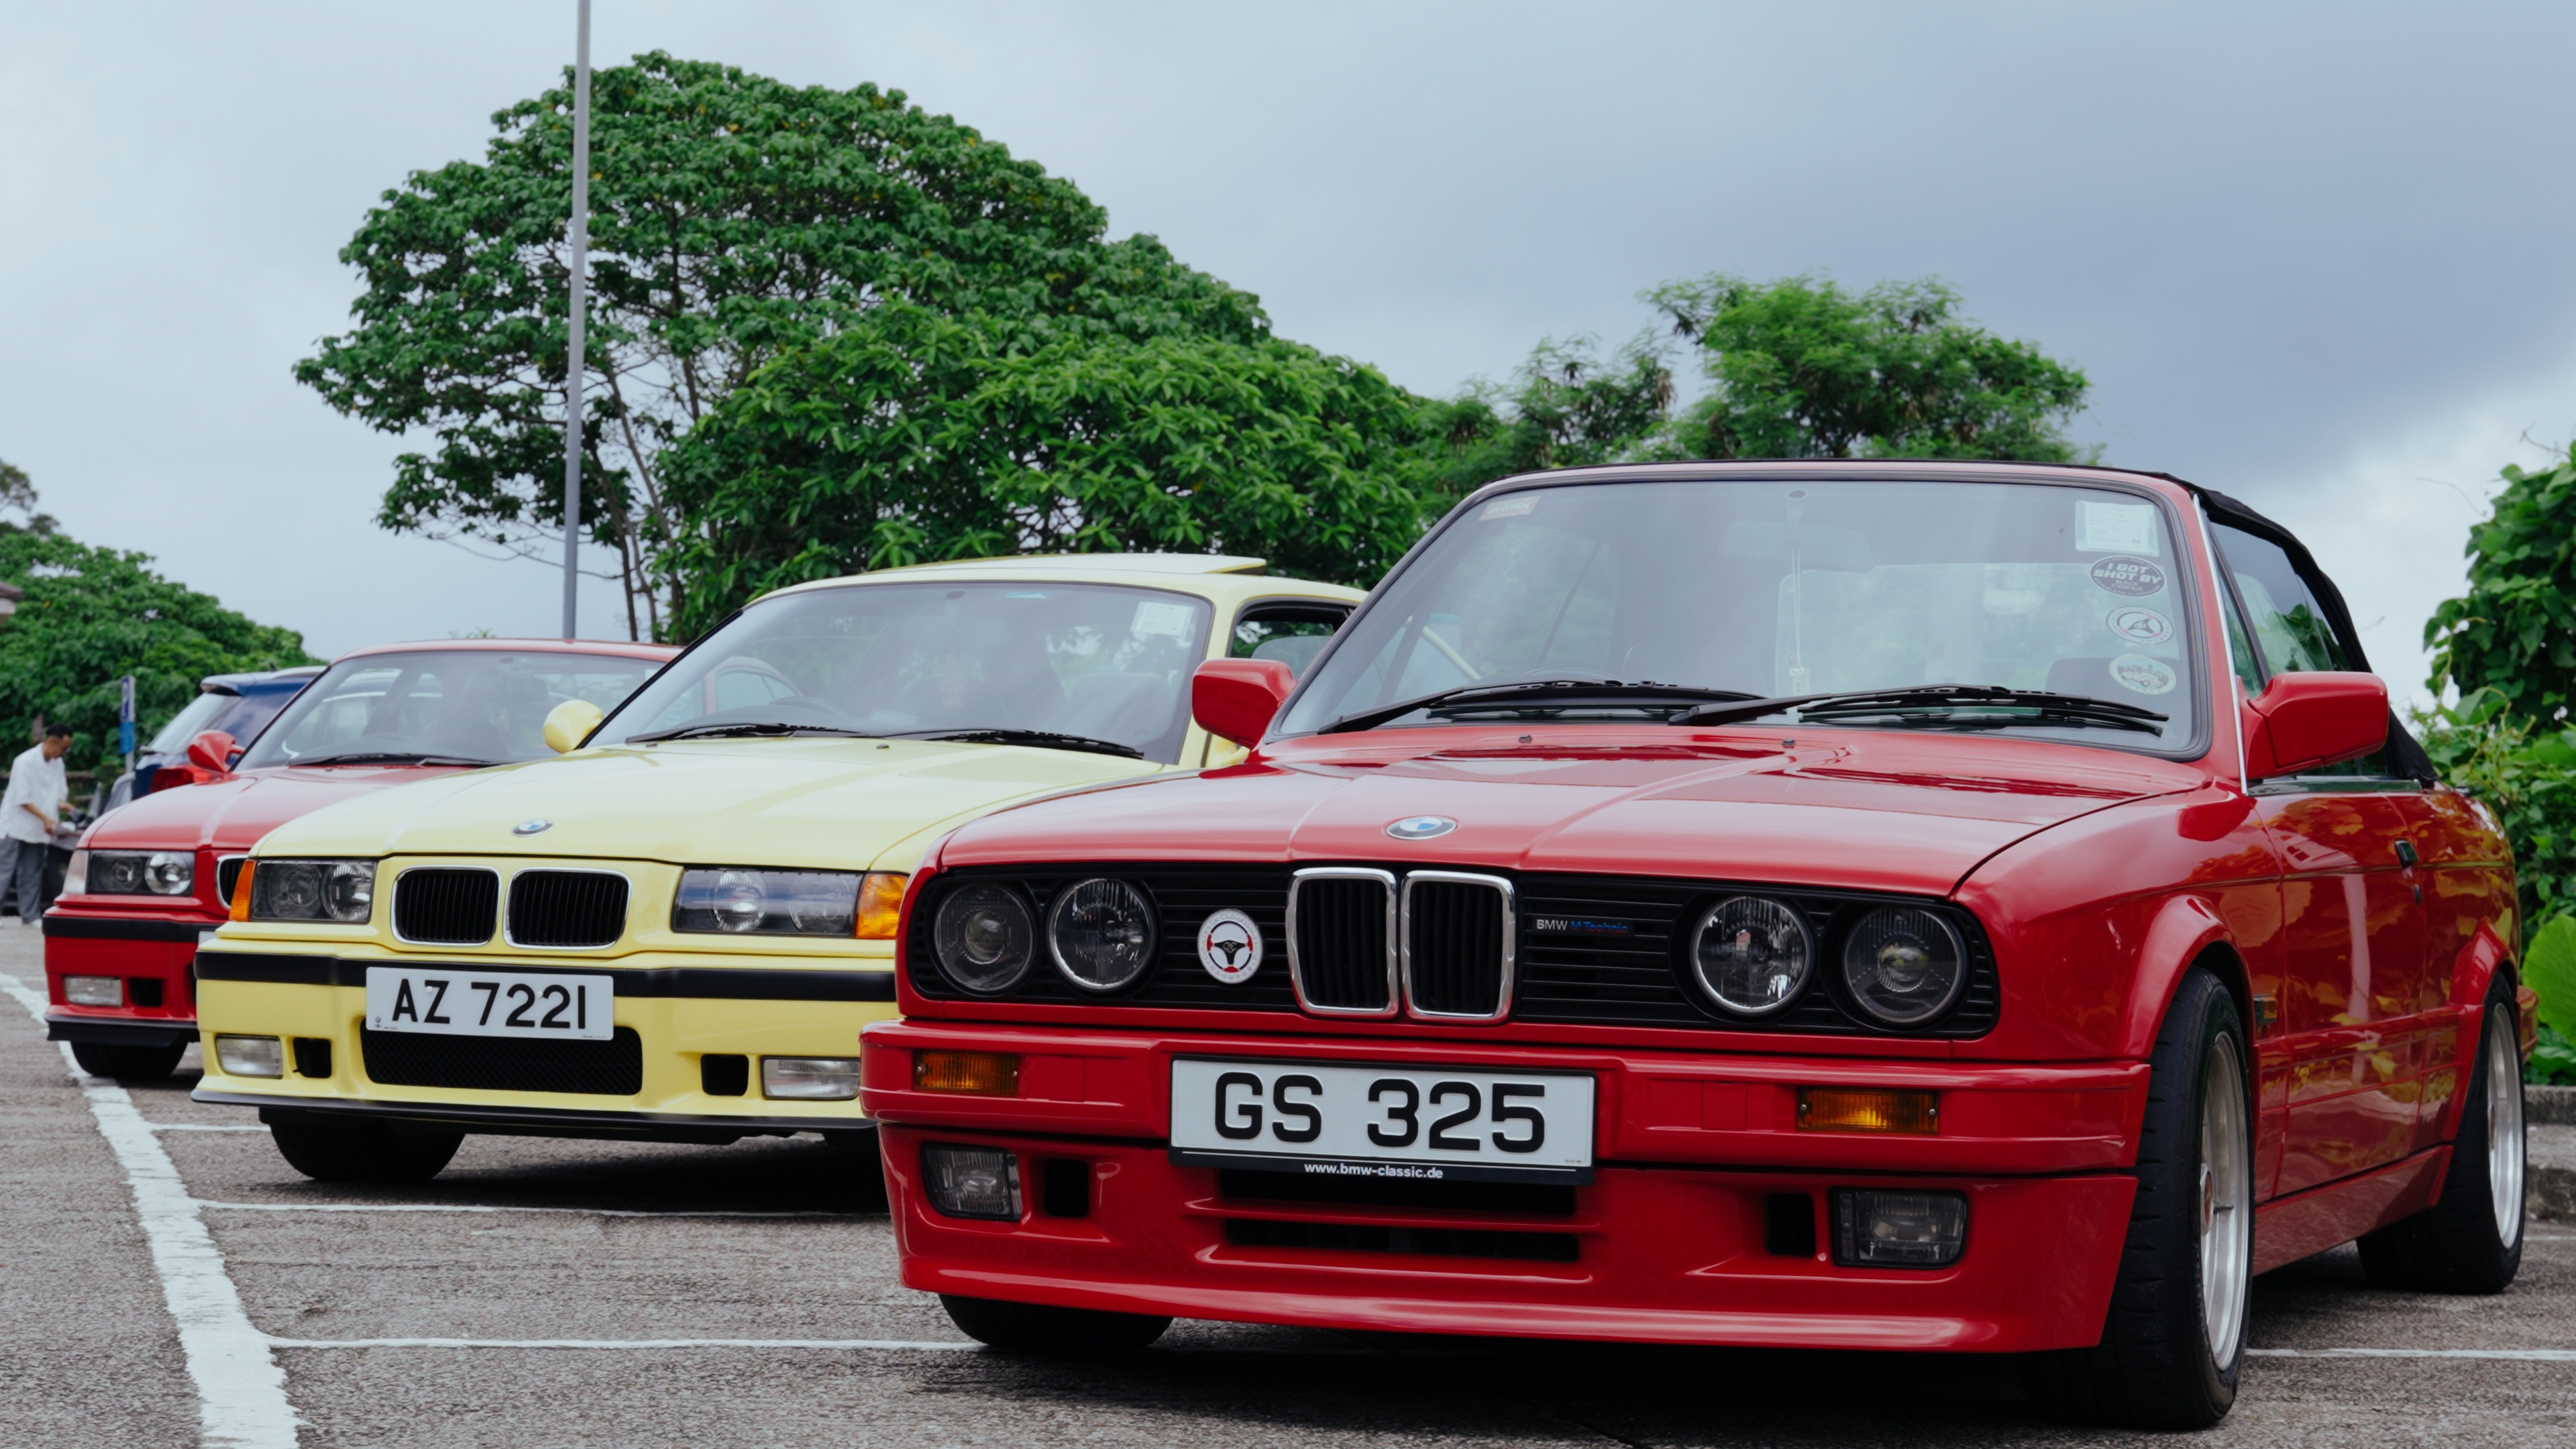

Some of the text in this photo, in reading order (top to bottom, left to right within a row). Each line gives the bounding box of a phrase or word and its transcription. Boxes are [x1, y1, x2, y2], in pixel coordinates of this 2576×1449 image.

[2107, 562, 2149, 574] I GOT
[2093, 570, 2162, 584] SHOT BY
[1536, 919, 1628, 934] BMW M Technic
[392, 978, 586, 1029] AZ 7221
[1215, 1071, 1546, 1154] GS 325
[1304, 1163, 1444, 1179] www.bmw-classic.de
